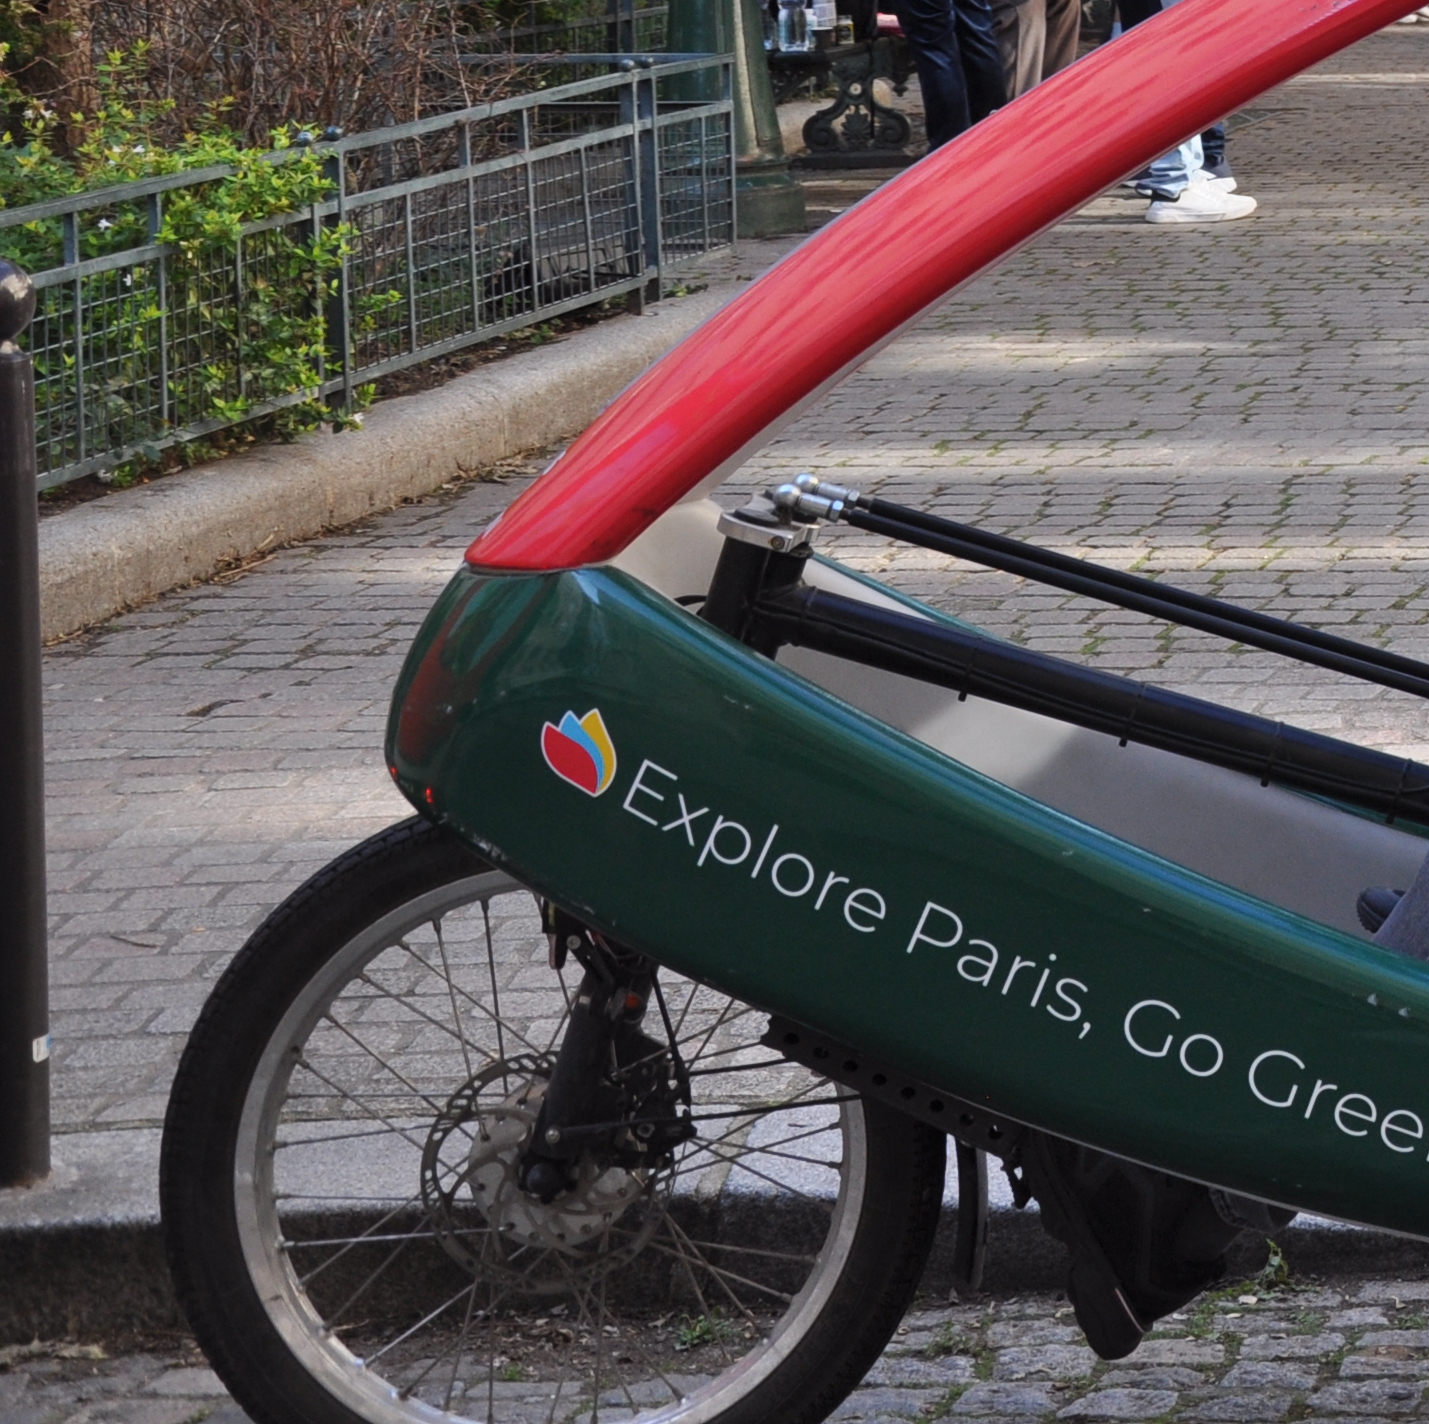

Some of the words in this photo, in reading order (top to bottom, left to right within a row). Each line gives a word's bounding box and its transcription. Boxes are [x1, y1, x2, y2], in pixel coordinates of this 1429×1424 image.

[622, 757, 888, 935] Explore
[905, 899, 1094, 1040] Paris,
[1122, 996, 1225, 1079] Go
